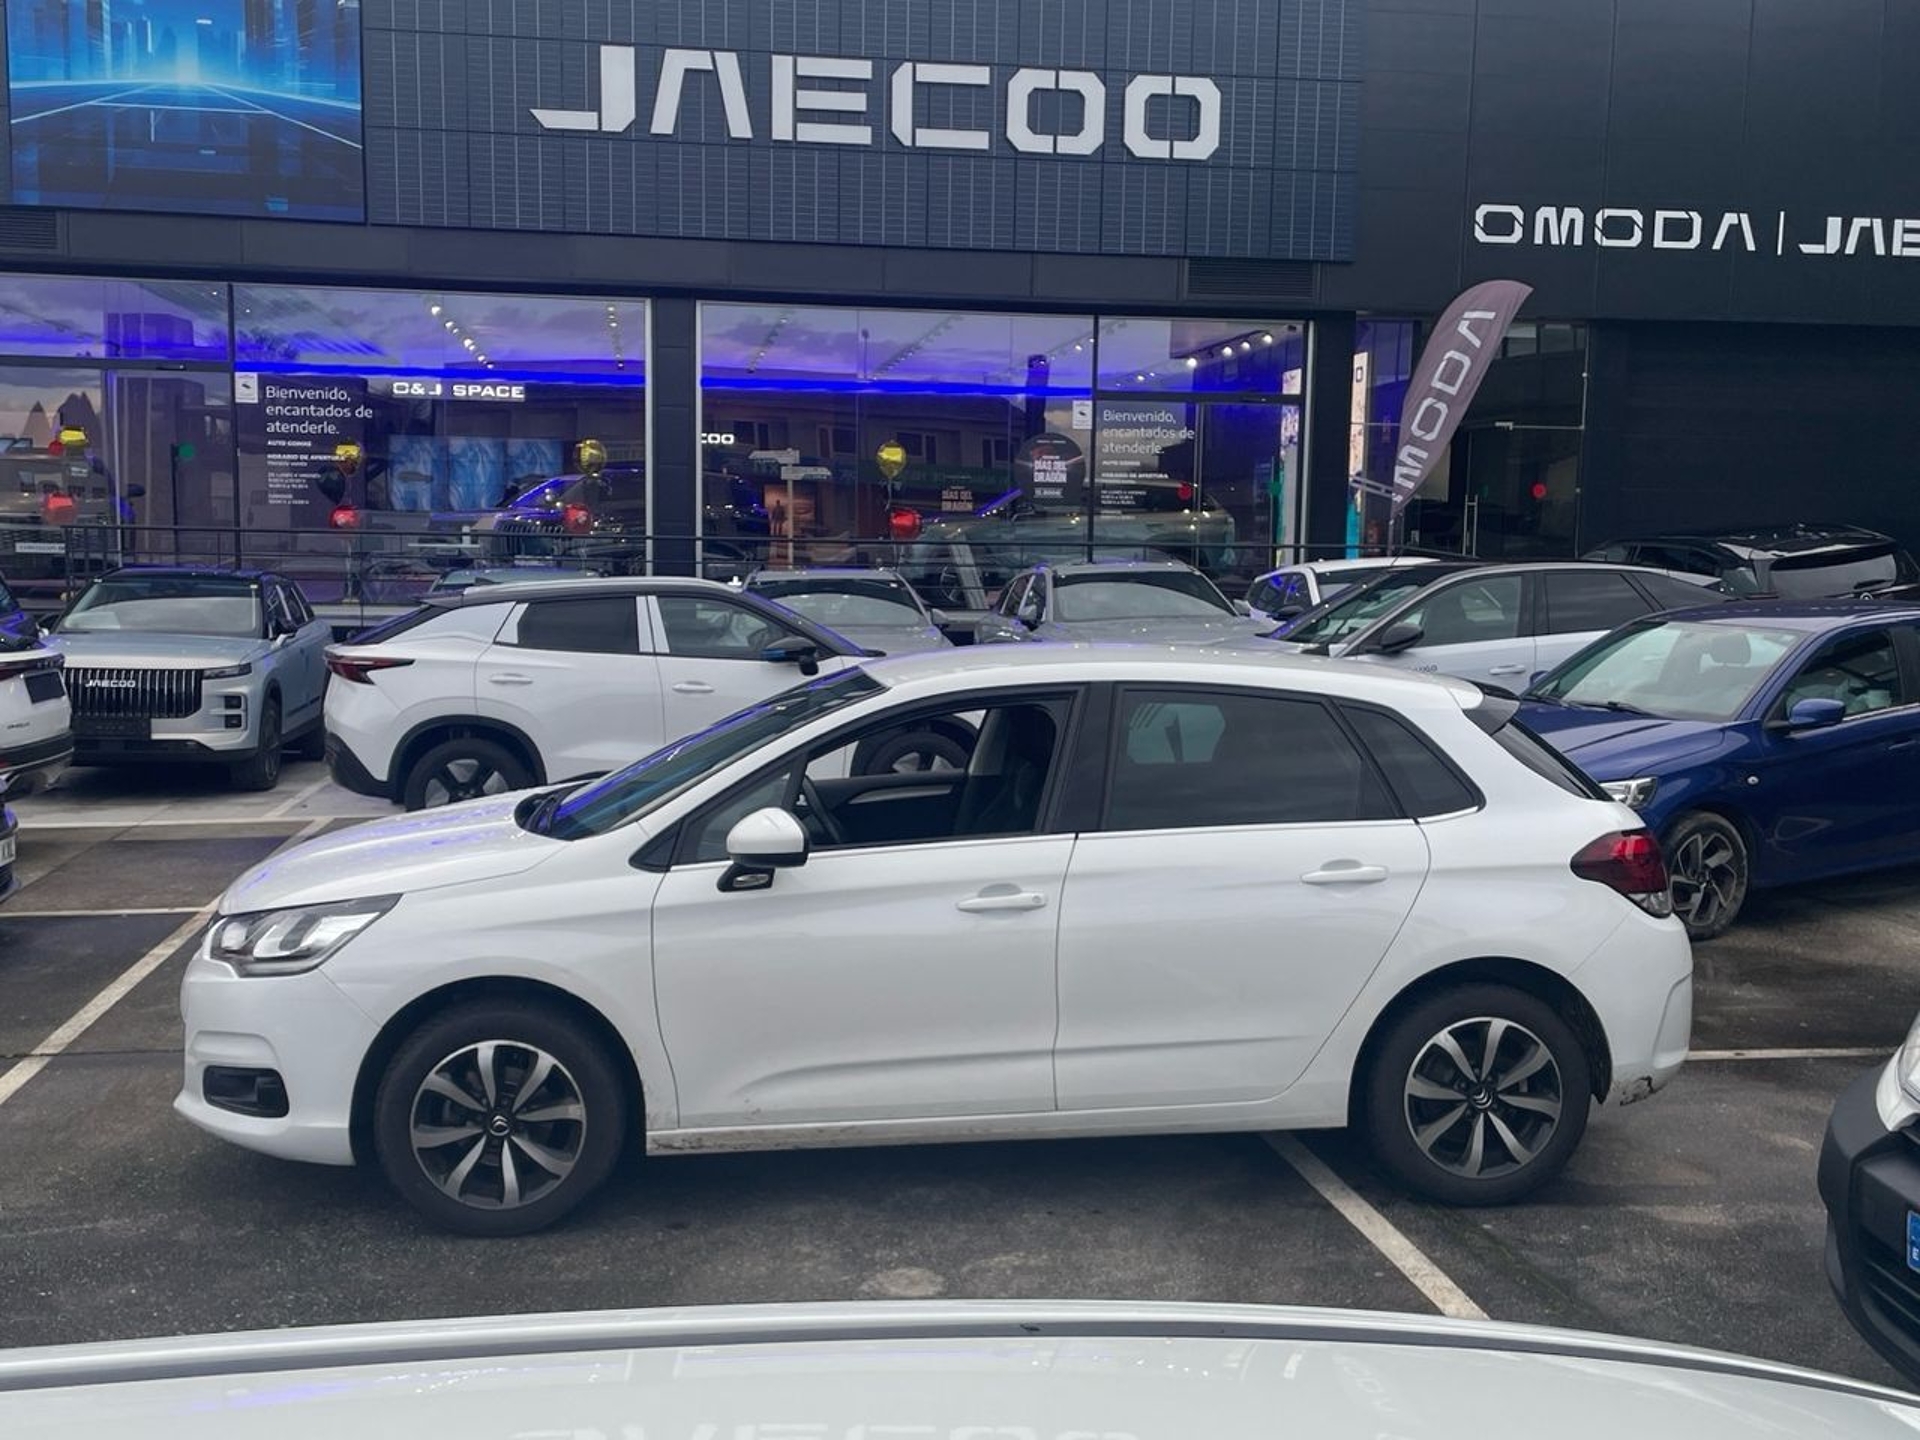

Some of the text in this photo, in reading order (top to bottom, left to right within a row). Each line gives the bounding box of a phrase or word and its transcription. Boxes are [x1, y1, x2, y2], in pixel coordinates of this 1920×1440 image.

[529, 44, 1222, 161] JAECOO
[1474, 203, 1757, 252] OMODA
[265, 385, 351, 402] Bienvenido,
[452, 384, 525, 398] SPACE
[265, 404, 373, 419] encantados de
[1103, 409, 1177, 424] Bienvenido,
[265, 420, 340, 435] atenderle.
[1102, 426, 1195, 440] encantados de
[1102, 441, 1165, 455] atenderle.
[85, 679, 136, 688] JAECOO
